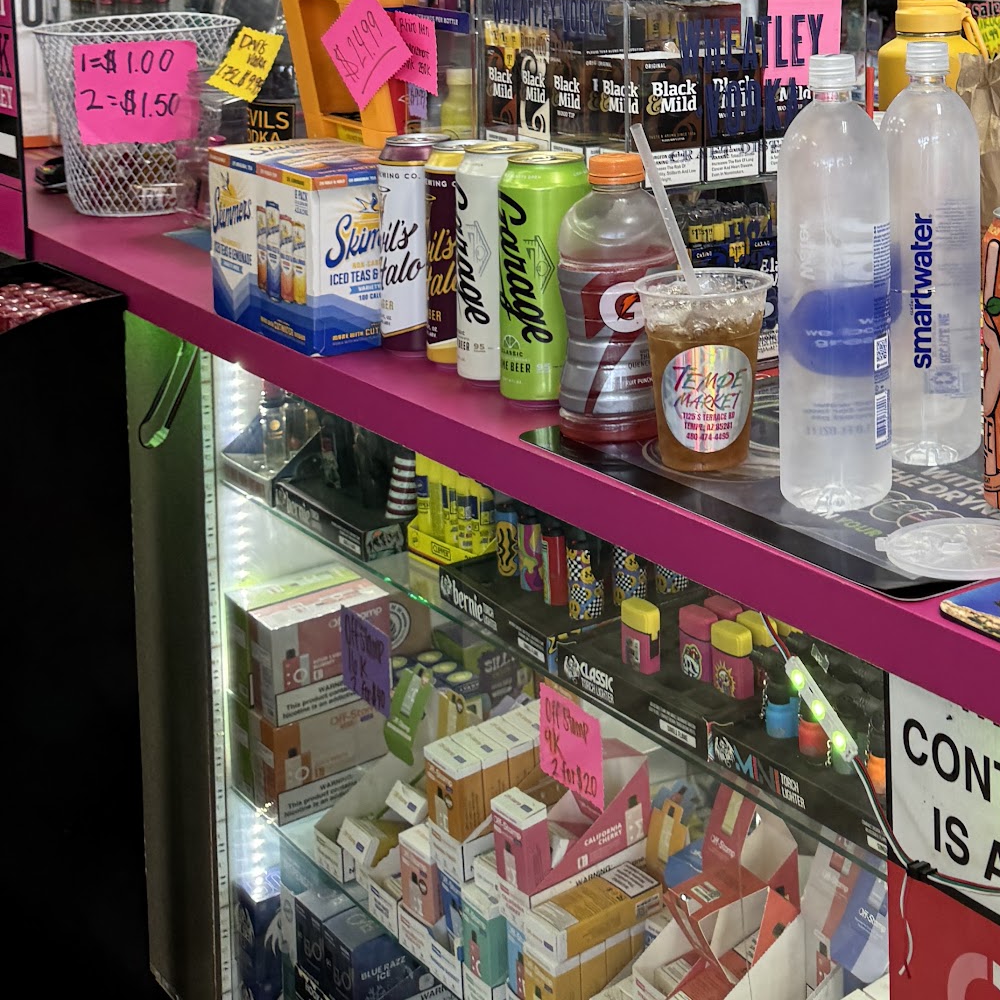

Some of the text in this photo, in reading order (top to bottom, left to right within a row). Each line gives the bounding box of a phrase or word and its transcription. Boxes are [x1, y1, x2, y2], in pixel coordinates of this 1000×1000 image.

[677, 13, 825, 76] WHEATLEY
[489, 65, 513, 85] Black
[522, 68, 547, 87] Black
[553, 73, 580, 94] Black
[492, 81, 513, 101] Mild
[525, 85, 547, 104] Mild
[651, 79, 698, 98] Black
[558, 90, 582, 112] Mild
[646, 94, 698, 116] & Mild
[705, 76, 799, 139] VODKA
[329, 270, 379, 286] ICED TEAS &
[912, 212, 934, 370] smartwater
[509, 363, 532, 374] BEER
[673, 364, 748, 392] TEMPE
[674, 389, 744, 412] MARKET
[838, 517, 884, 538] YOUR
[450, 579, 484, 623] bernie
[579, 662, 615, 692] CLASSIC
[736, 753, 799, 796] MINI TORCH
[781, 786, 806, 810] LIGHTER
[584, 821, 623, 847] CALIFORNIA
[597, 830, 623, 847] CHERRY
[932, 807, 970, 867] IS
[361, 954, 407, 981] BLUE RAZZ
[376, 969, 391, 981] ICE
